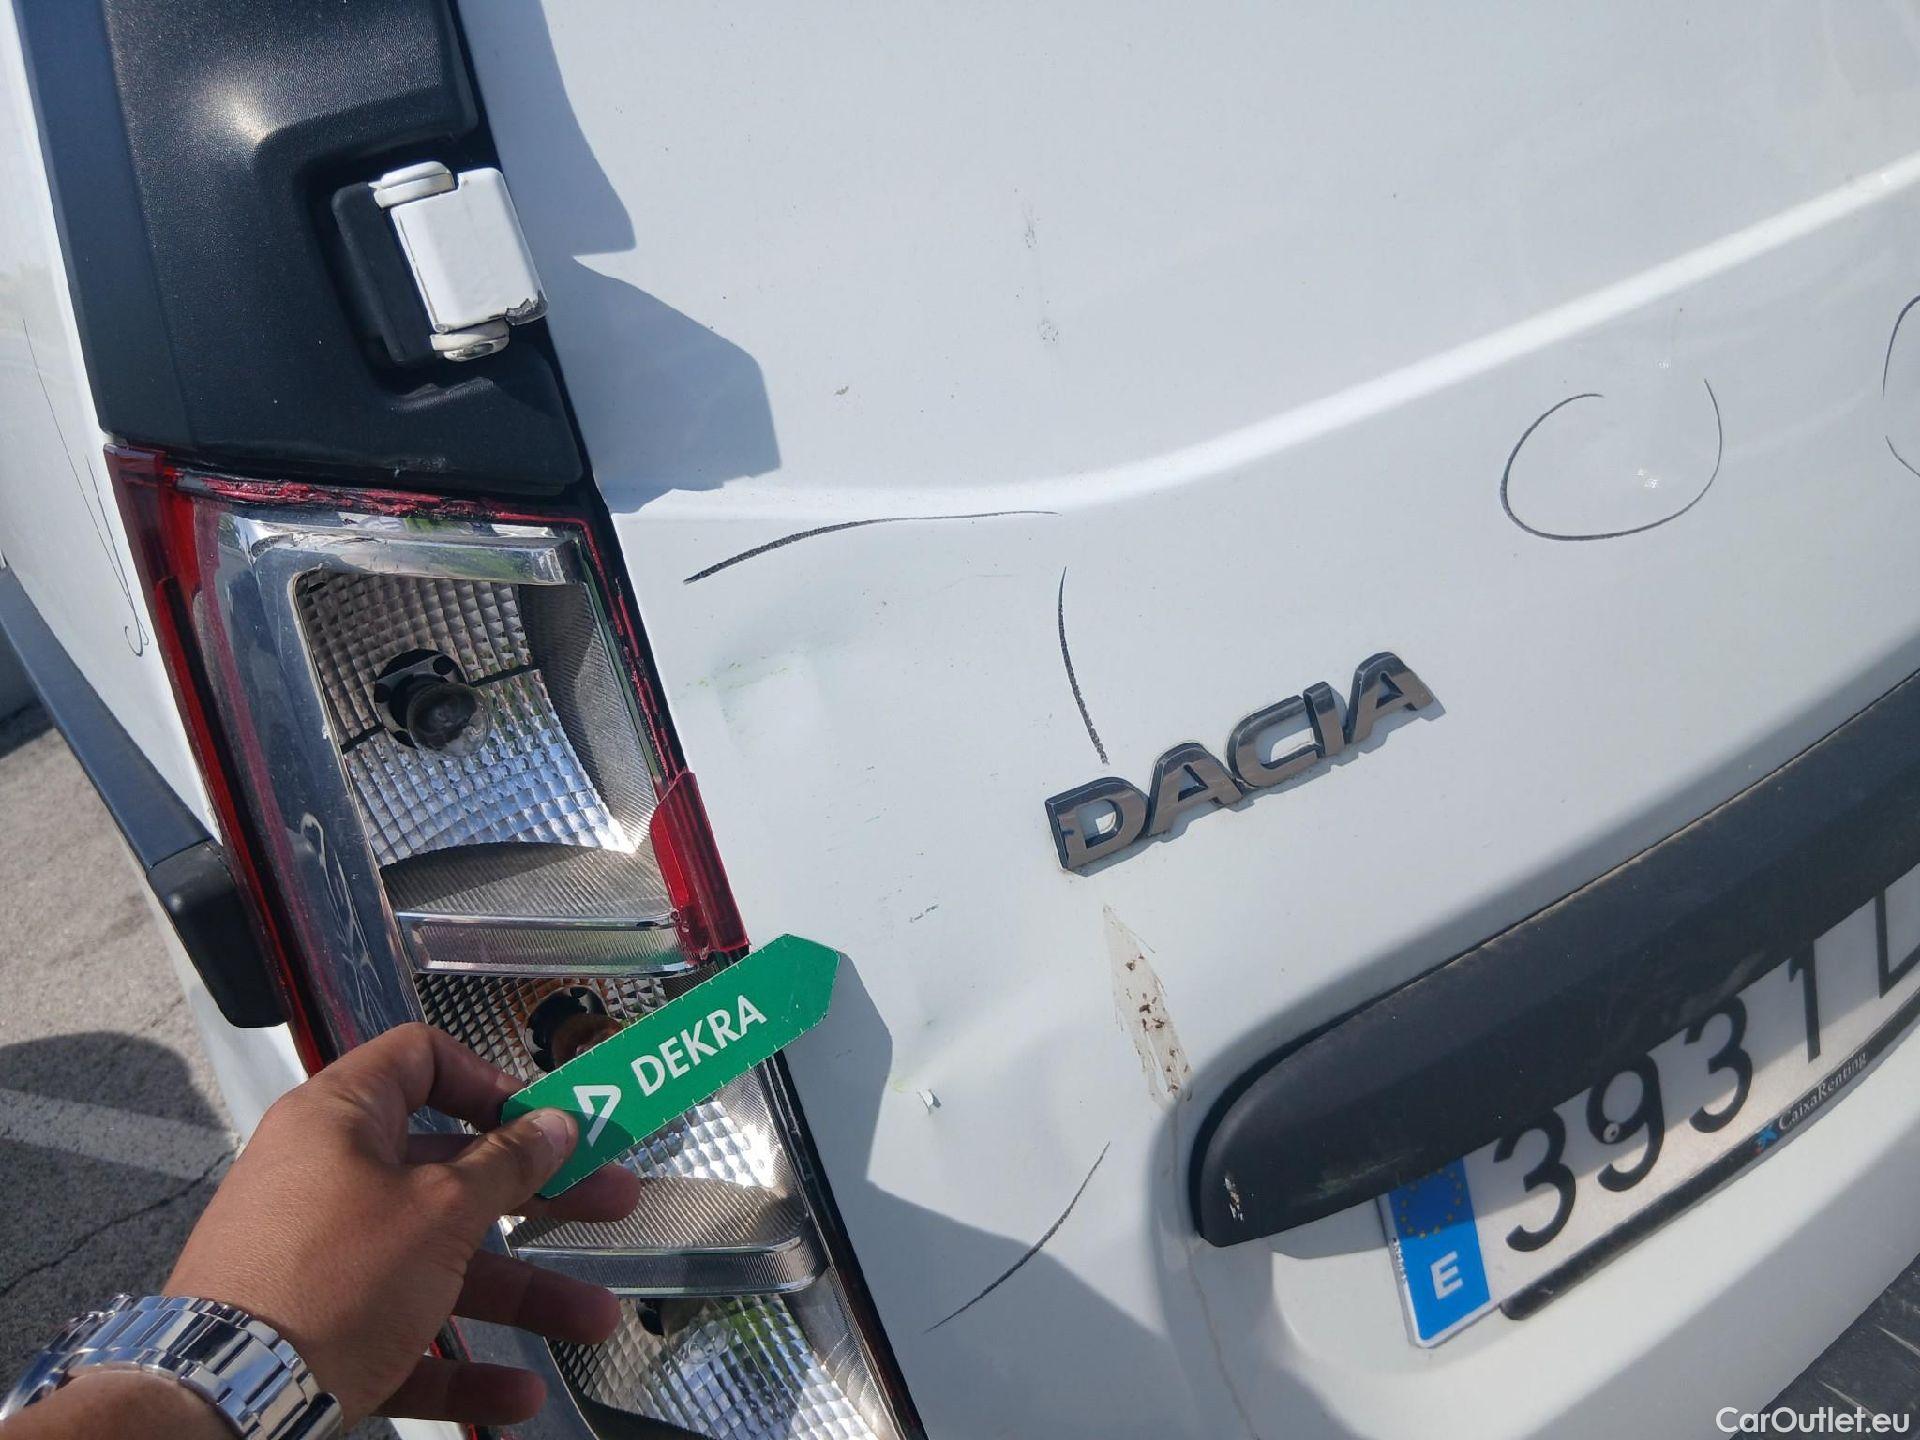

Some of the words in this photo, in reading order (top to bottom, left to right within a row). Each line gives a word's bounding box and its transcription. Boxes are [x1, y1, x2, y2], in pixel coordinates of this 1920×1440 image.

[1045, 651, 1436, 869] DACIA
[630, 994, 768, 1097] DEKRA
[1492, 940, 1821, 1253] 3931
[1778, 1051, 1869, 1132] CaixaRenting
[1430, 1250, 1464, 1300] E
